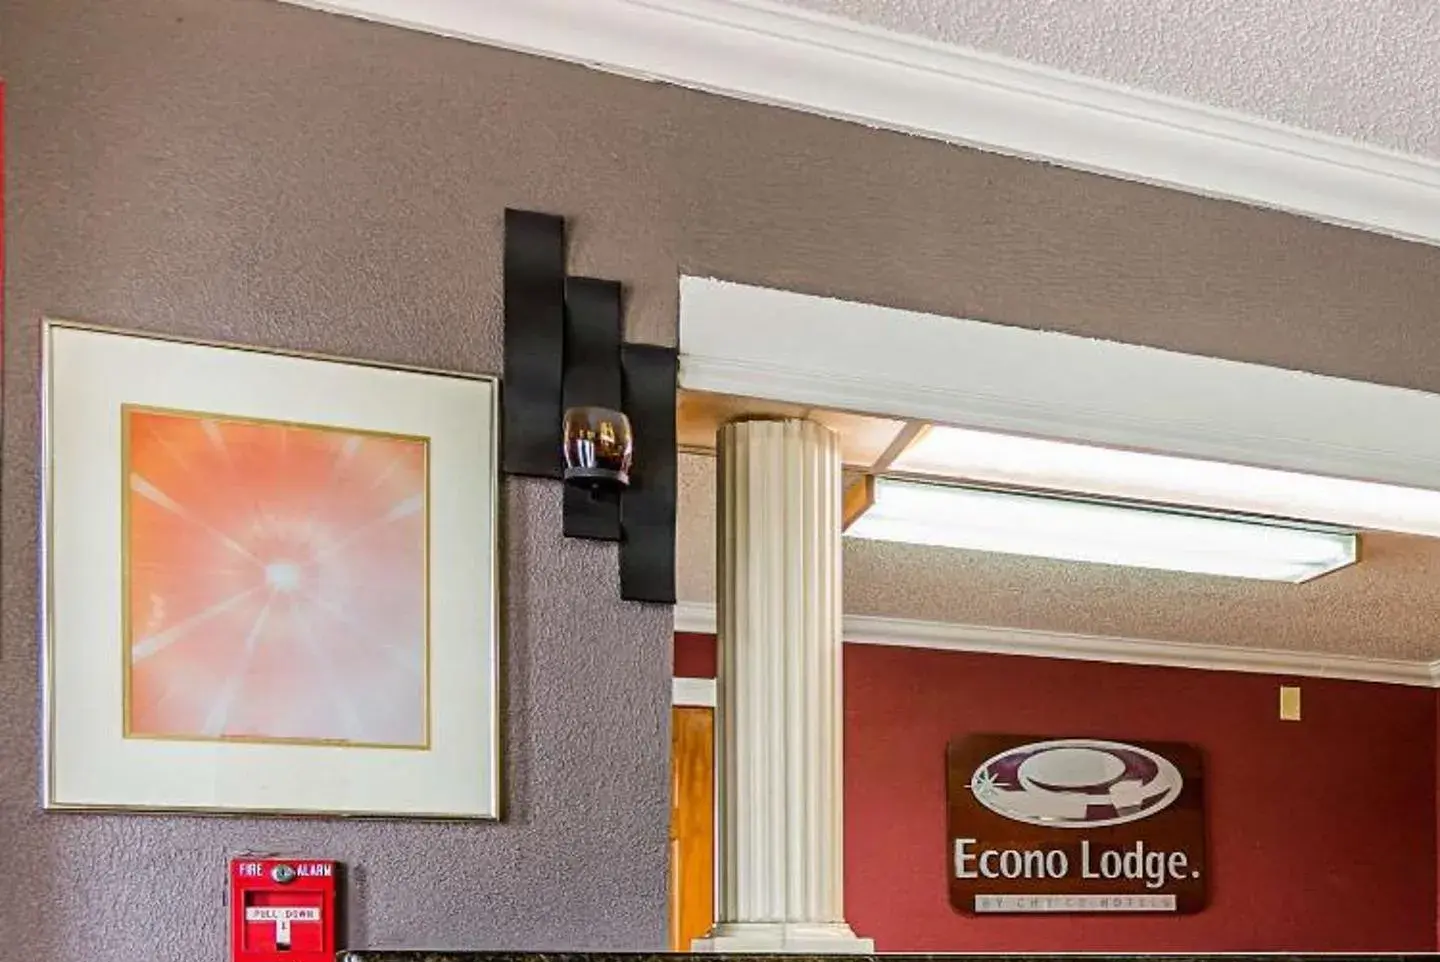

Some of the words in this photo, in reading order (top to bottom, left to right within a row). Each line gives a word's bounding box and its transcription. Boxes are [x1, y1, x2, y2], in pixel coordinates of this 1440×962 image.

[239, 863, 263, 876] FIRE
[297, 863, 332, 876] ALARM
[954, 838, 1069, 879] Econo
